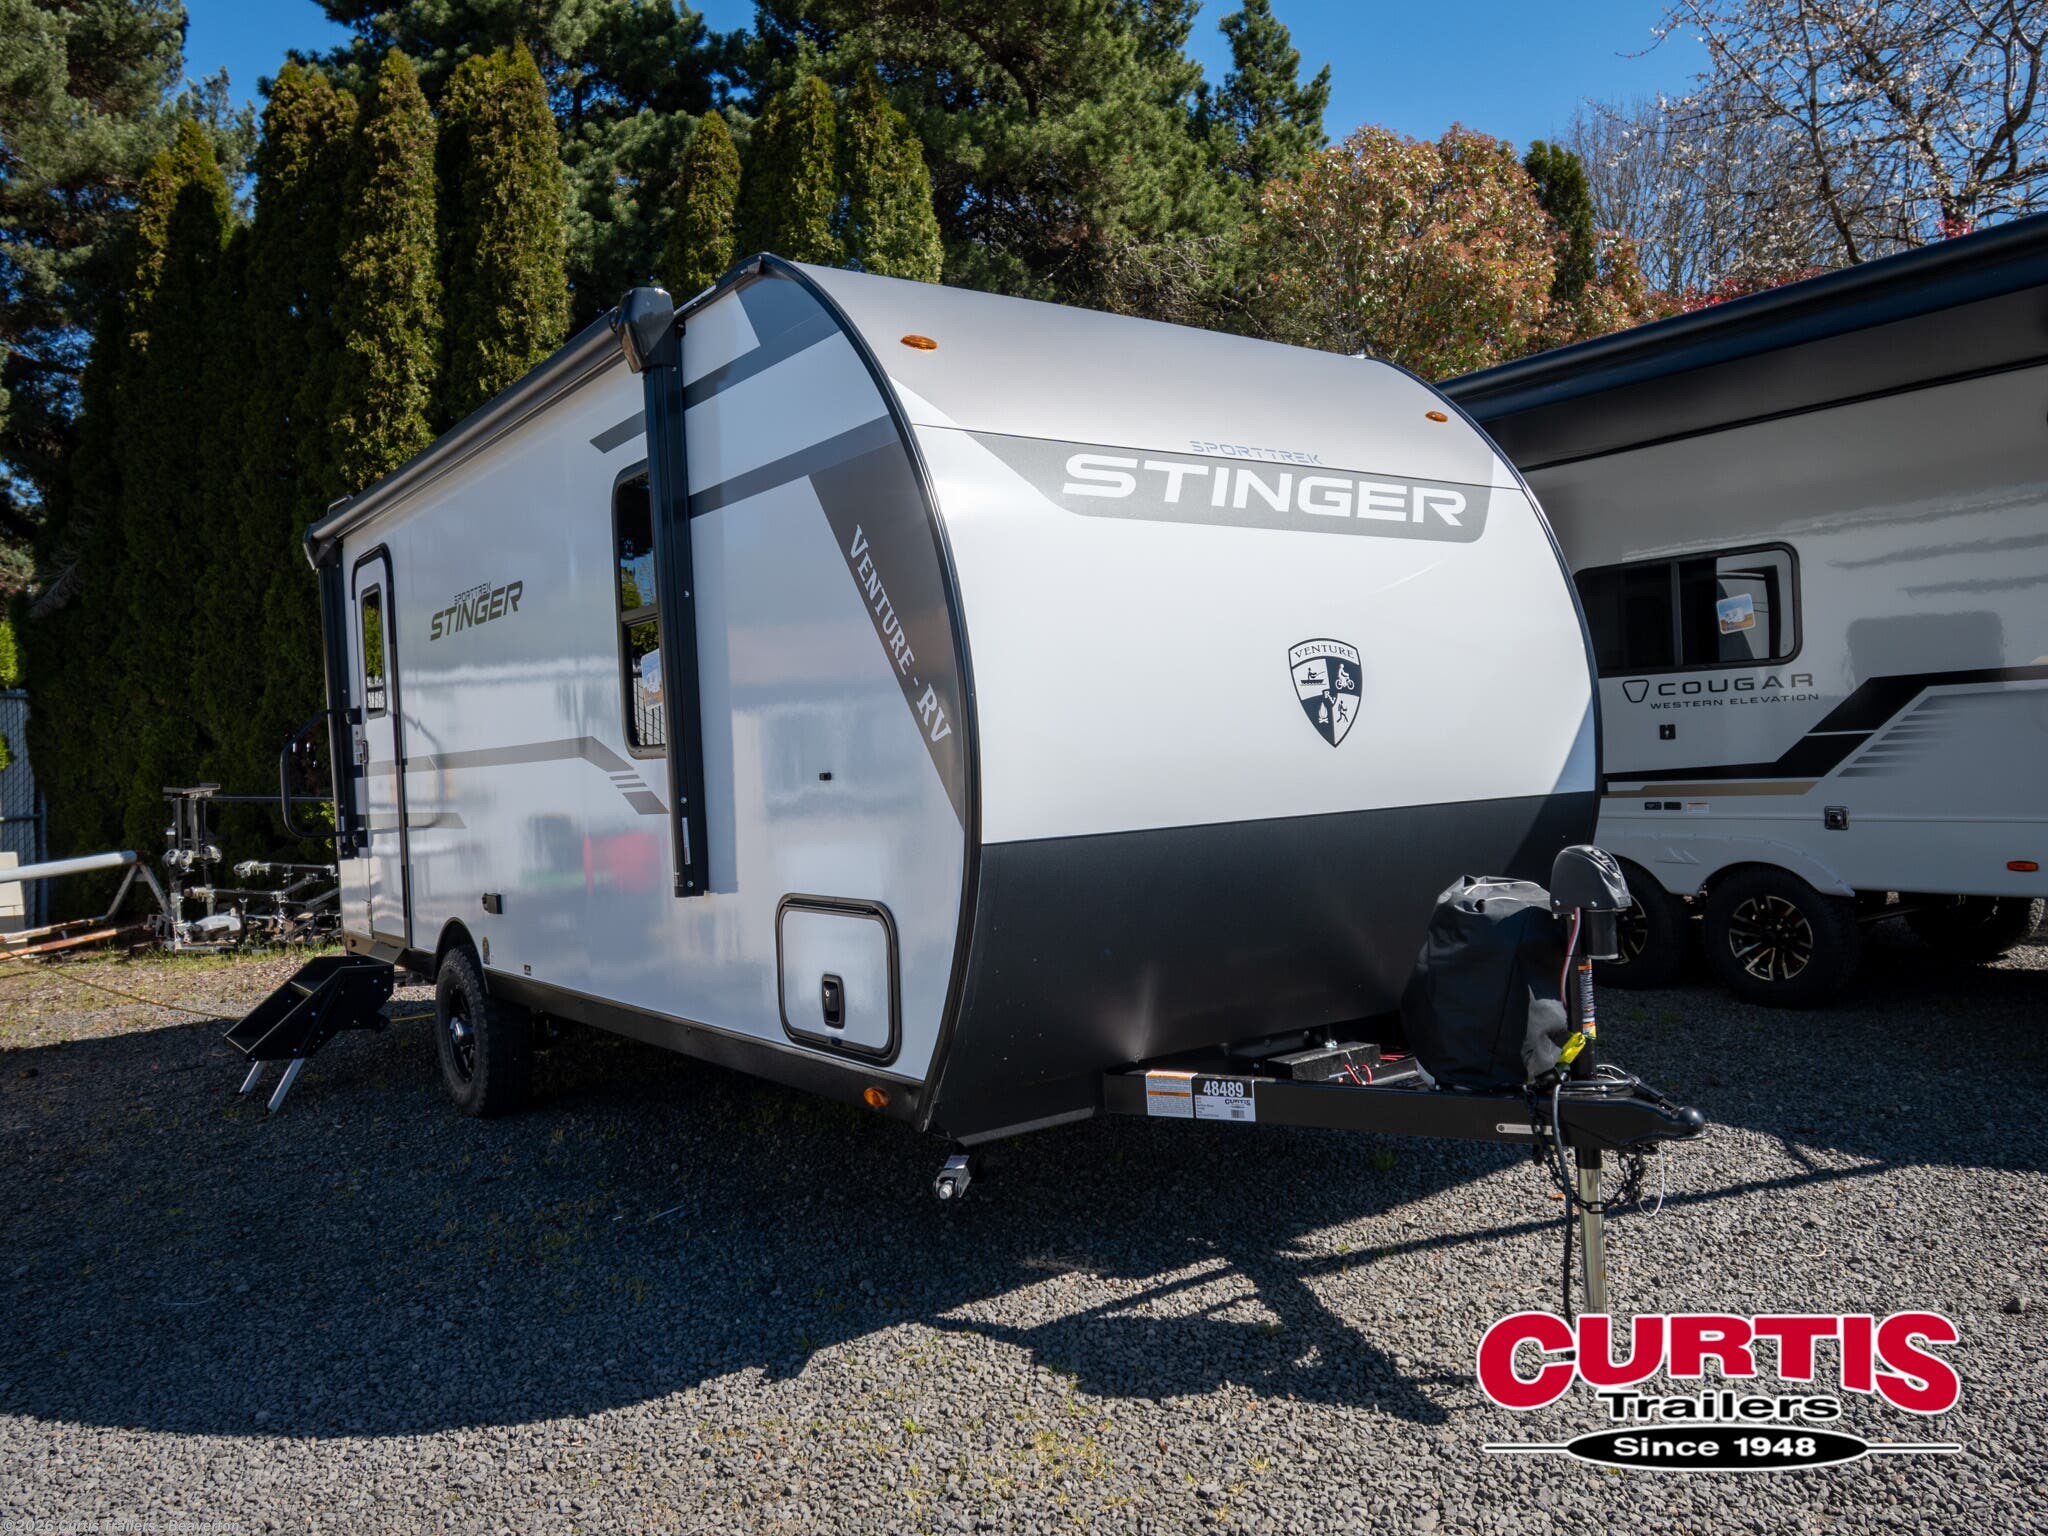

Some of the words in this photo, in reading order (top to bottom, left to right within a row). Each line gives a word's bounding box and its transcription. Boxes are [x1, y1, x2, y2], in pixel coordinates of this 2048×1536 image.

[1189, 440, 1323, 465] SPORTTREK
[1062, 453, 1468, 528] STINGER
[430, 580, 523, 641] STINGER
[850, 524, 915, 675] VENTURE
[916, 684, 952, 743] RV
[1294, 644, 1356, 659] VENTURE
[1658, 673, 1814, 696] COUGAR
[1650, 699, 1724, 710] WESTERN
[1729, 693, 1819, 706] ELEVATION
[1203, 1080, 1245, 1098] 48489
